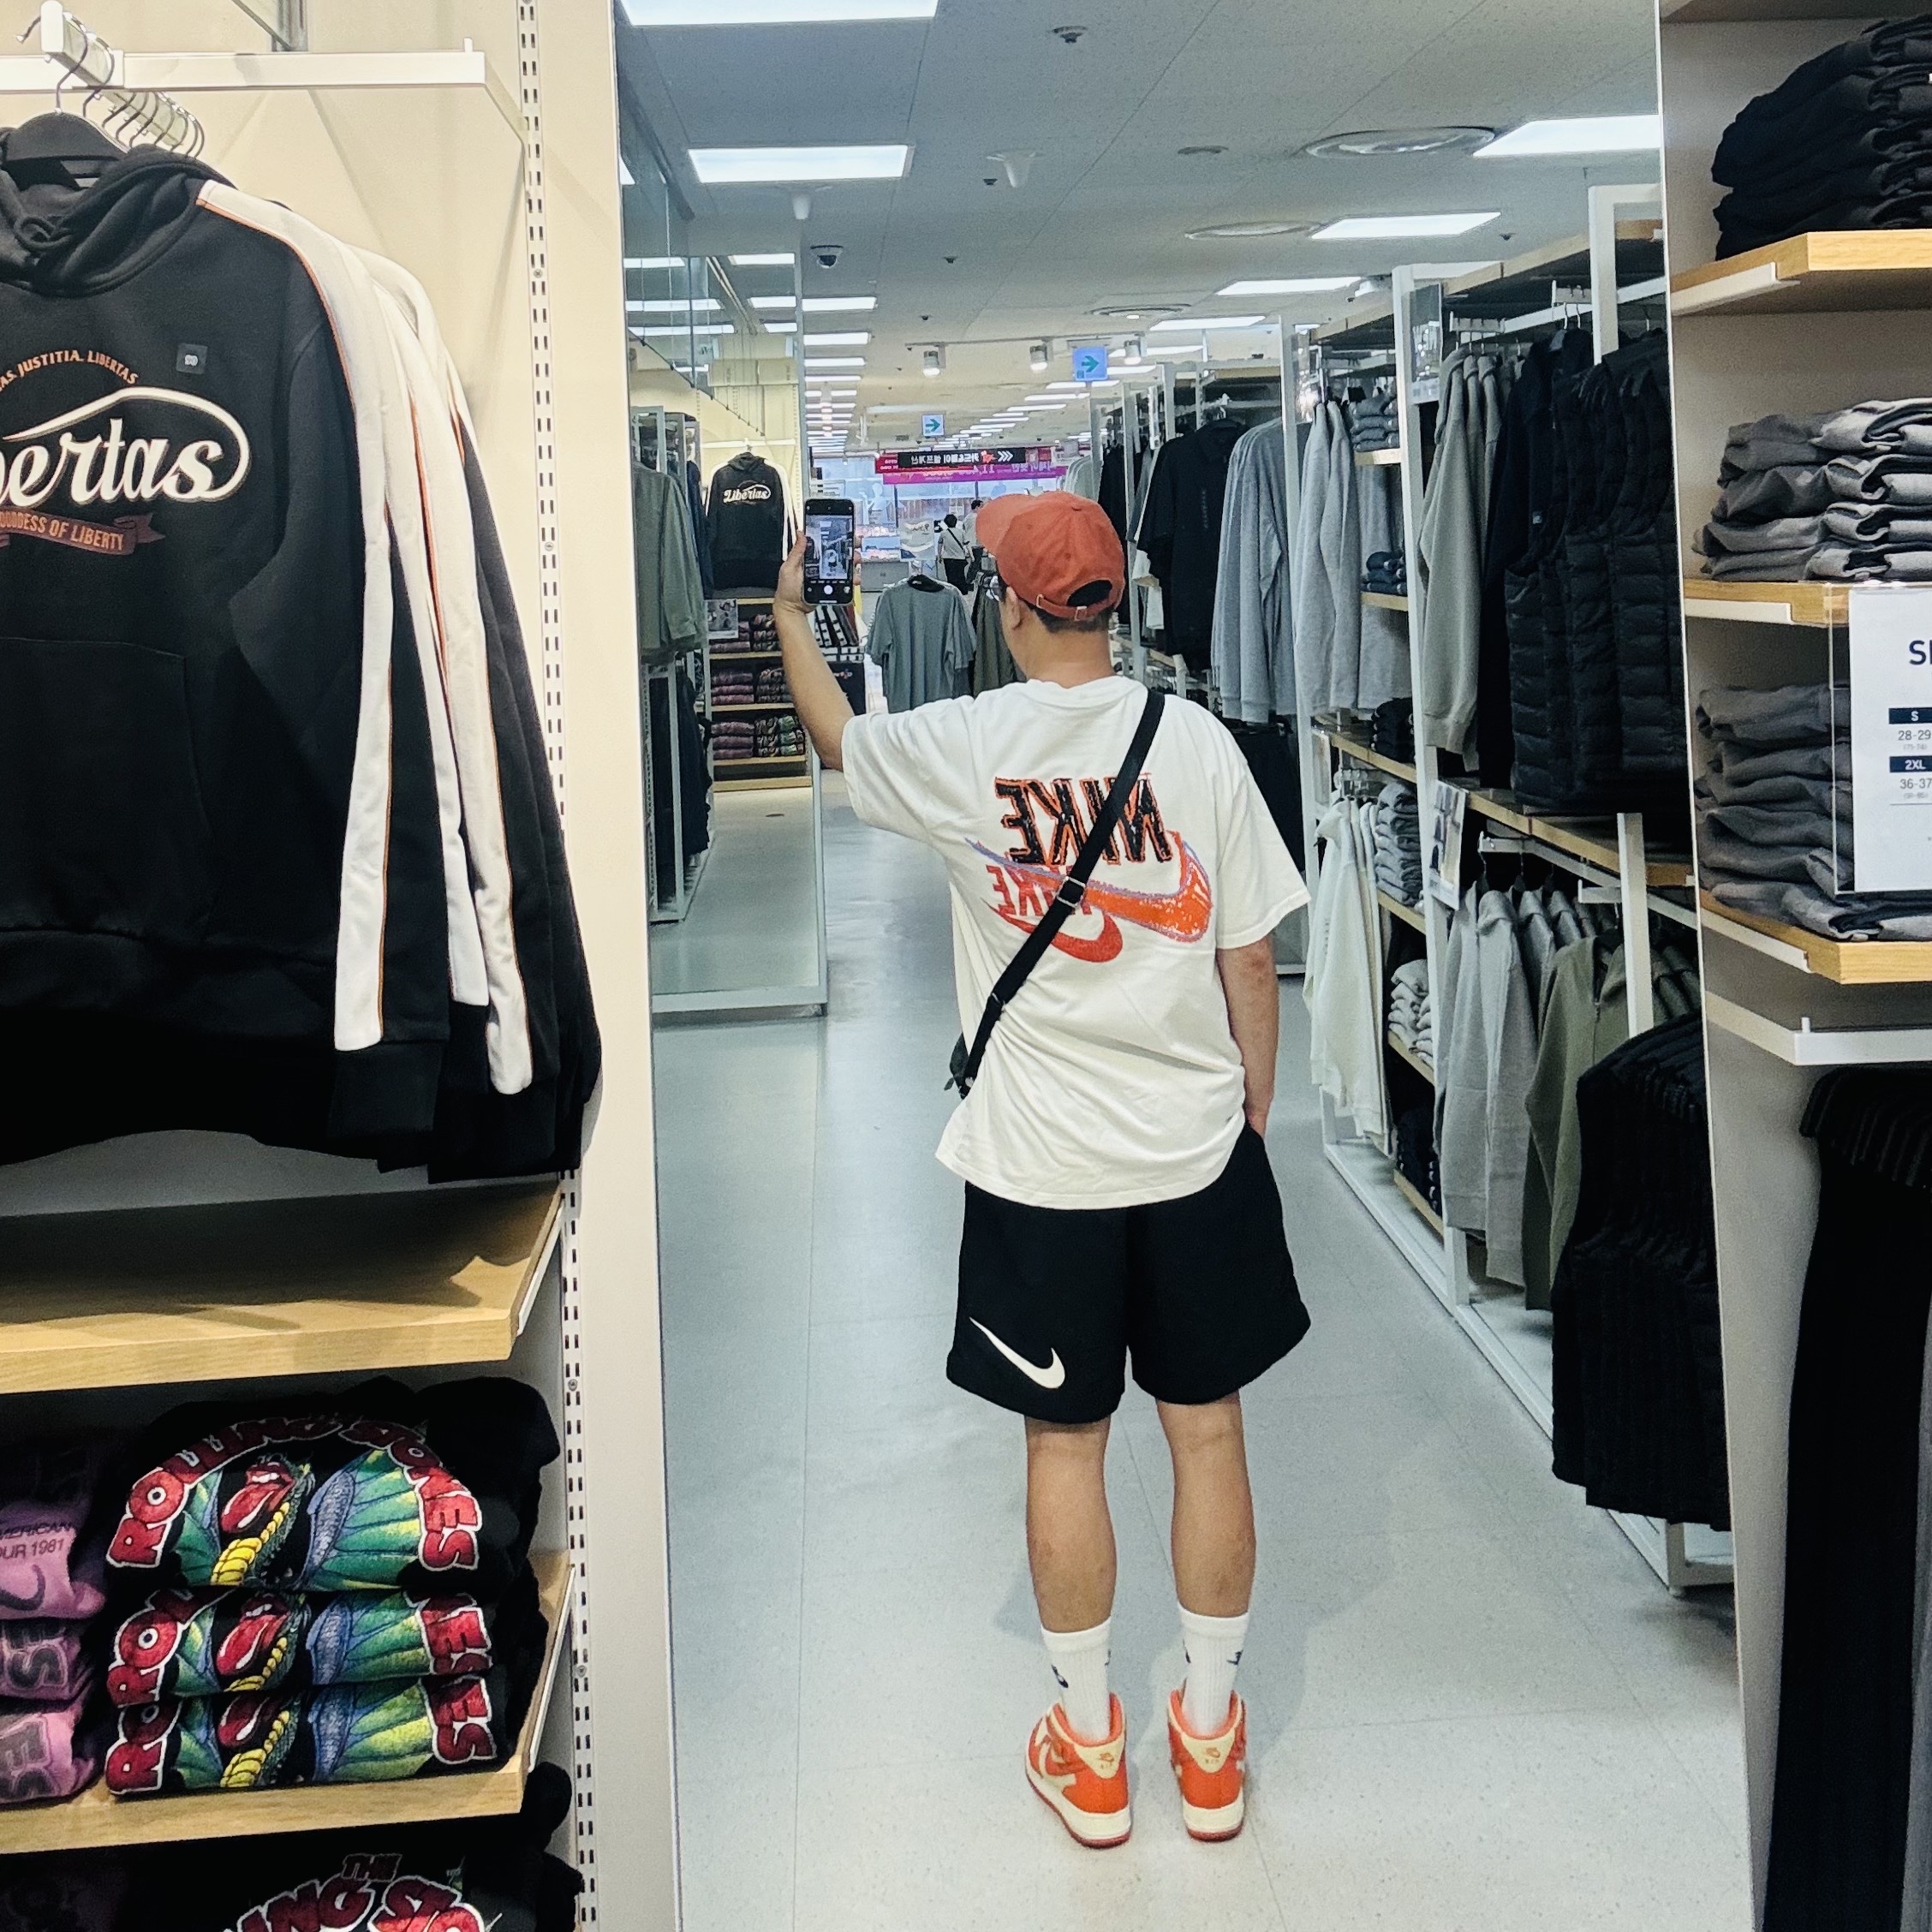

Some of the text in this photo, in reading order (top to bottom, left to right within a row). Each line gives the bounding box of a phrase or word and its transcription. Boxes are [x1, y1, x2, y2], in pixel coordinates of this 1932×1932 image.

[87, 350, 139, 385] LIBERTAS
[0, 396, 244, 507] ertas
[49, 519, 69, 539] OF
[70, 525, 124, 551] LIBERTY
[1911, 711, 1919, 722] S
[1898, 730, 1931, 741] 28-29
[1905, 759, 1927, 771] 2XL
[1899, 778, 1932, 790] 36-37
[32, 1538, 65, 1557] 1981
